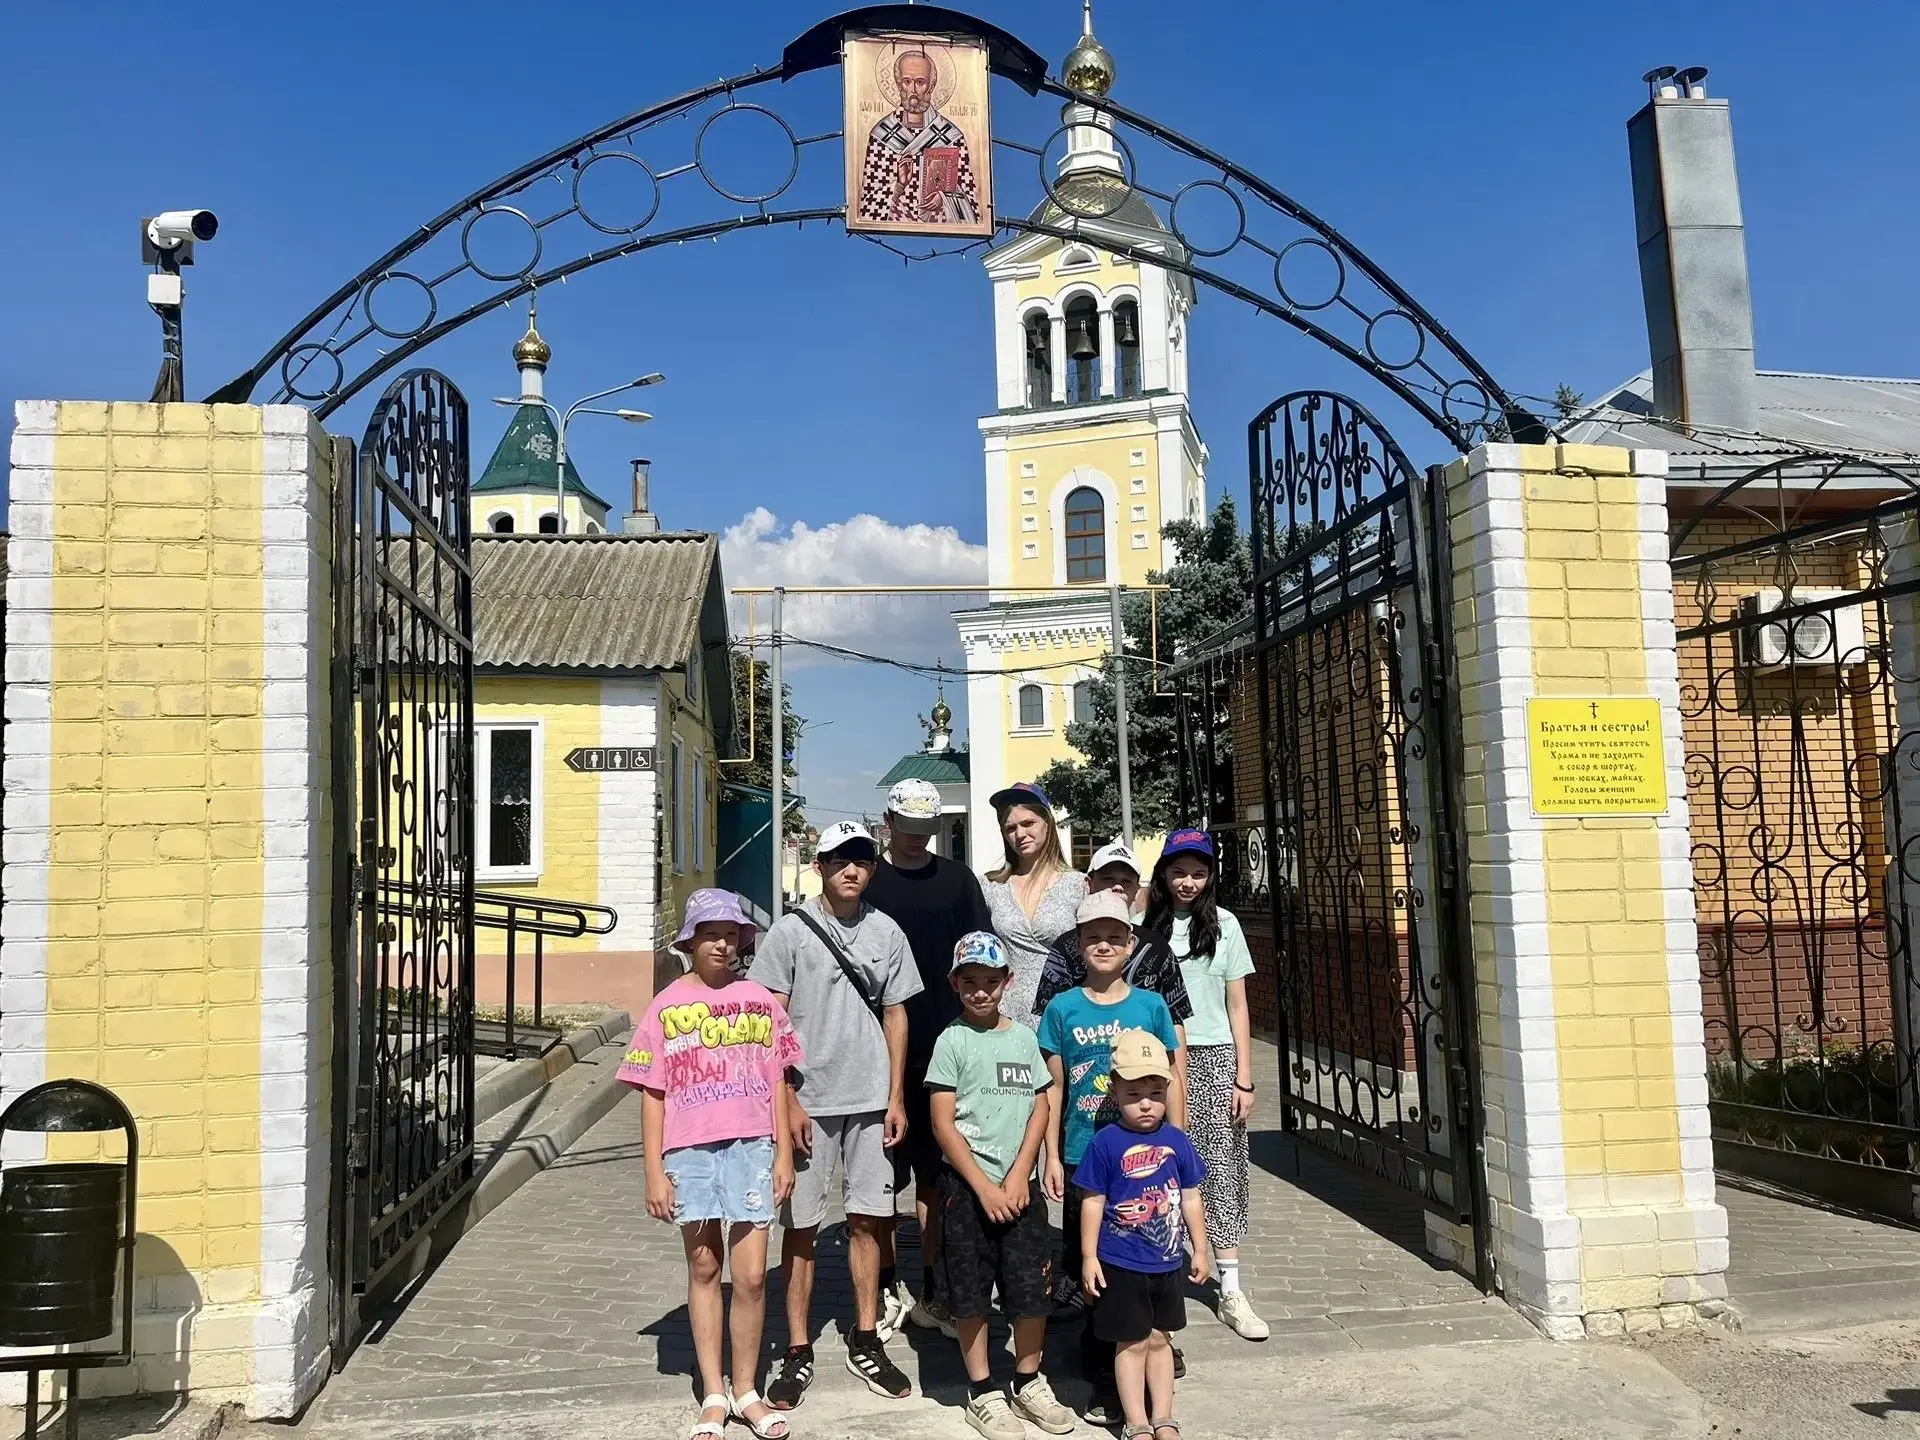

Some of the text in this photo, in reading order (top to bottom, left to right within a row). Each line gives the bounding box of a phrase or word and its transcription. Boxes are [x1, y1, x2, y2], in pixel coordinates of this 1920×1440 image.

[1541, 719, 1650, 734] Братья и сестры!
[1542, 739, 1576, 748] Просим
[1579, 740, 1607, 748] чтить
[1550, 750, 1579, 761] Храма
[1602, 752, 1644, 761] заходить
[1567, 763, 1590, 772] собор
[1600, 762, 1637, 772] шортах,
[1563, 785, 1636, 794] Головы женщин
[1541, 798, 1576, 806] должны
[1604, 797, 1660, 806] покрытыми.
[1121, 1148, 1163, 1173] BLAZE
